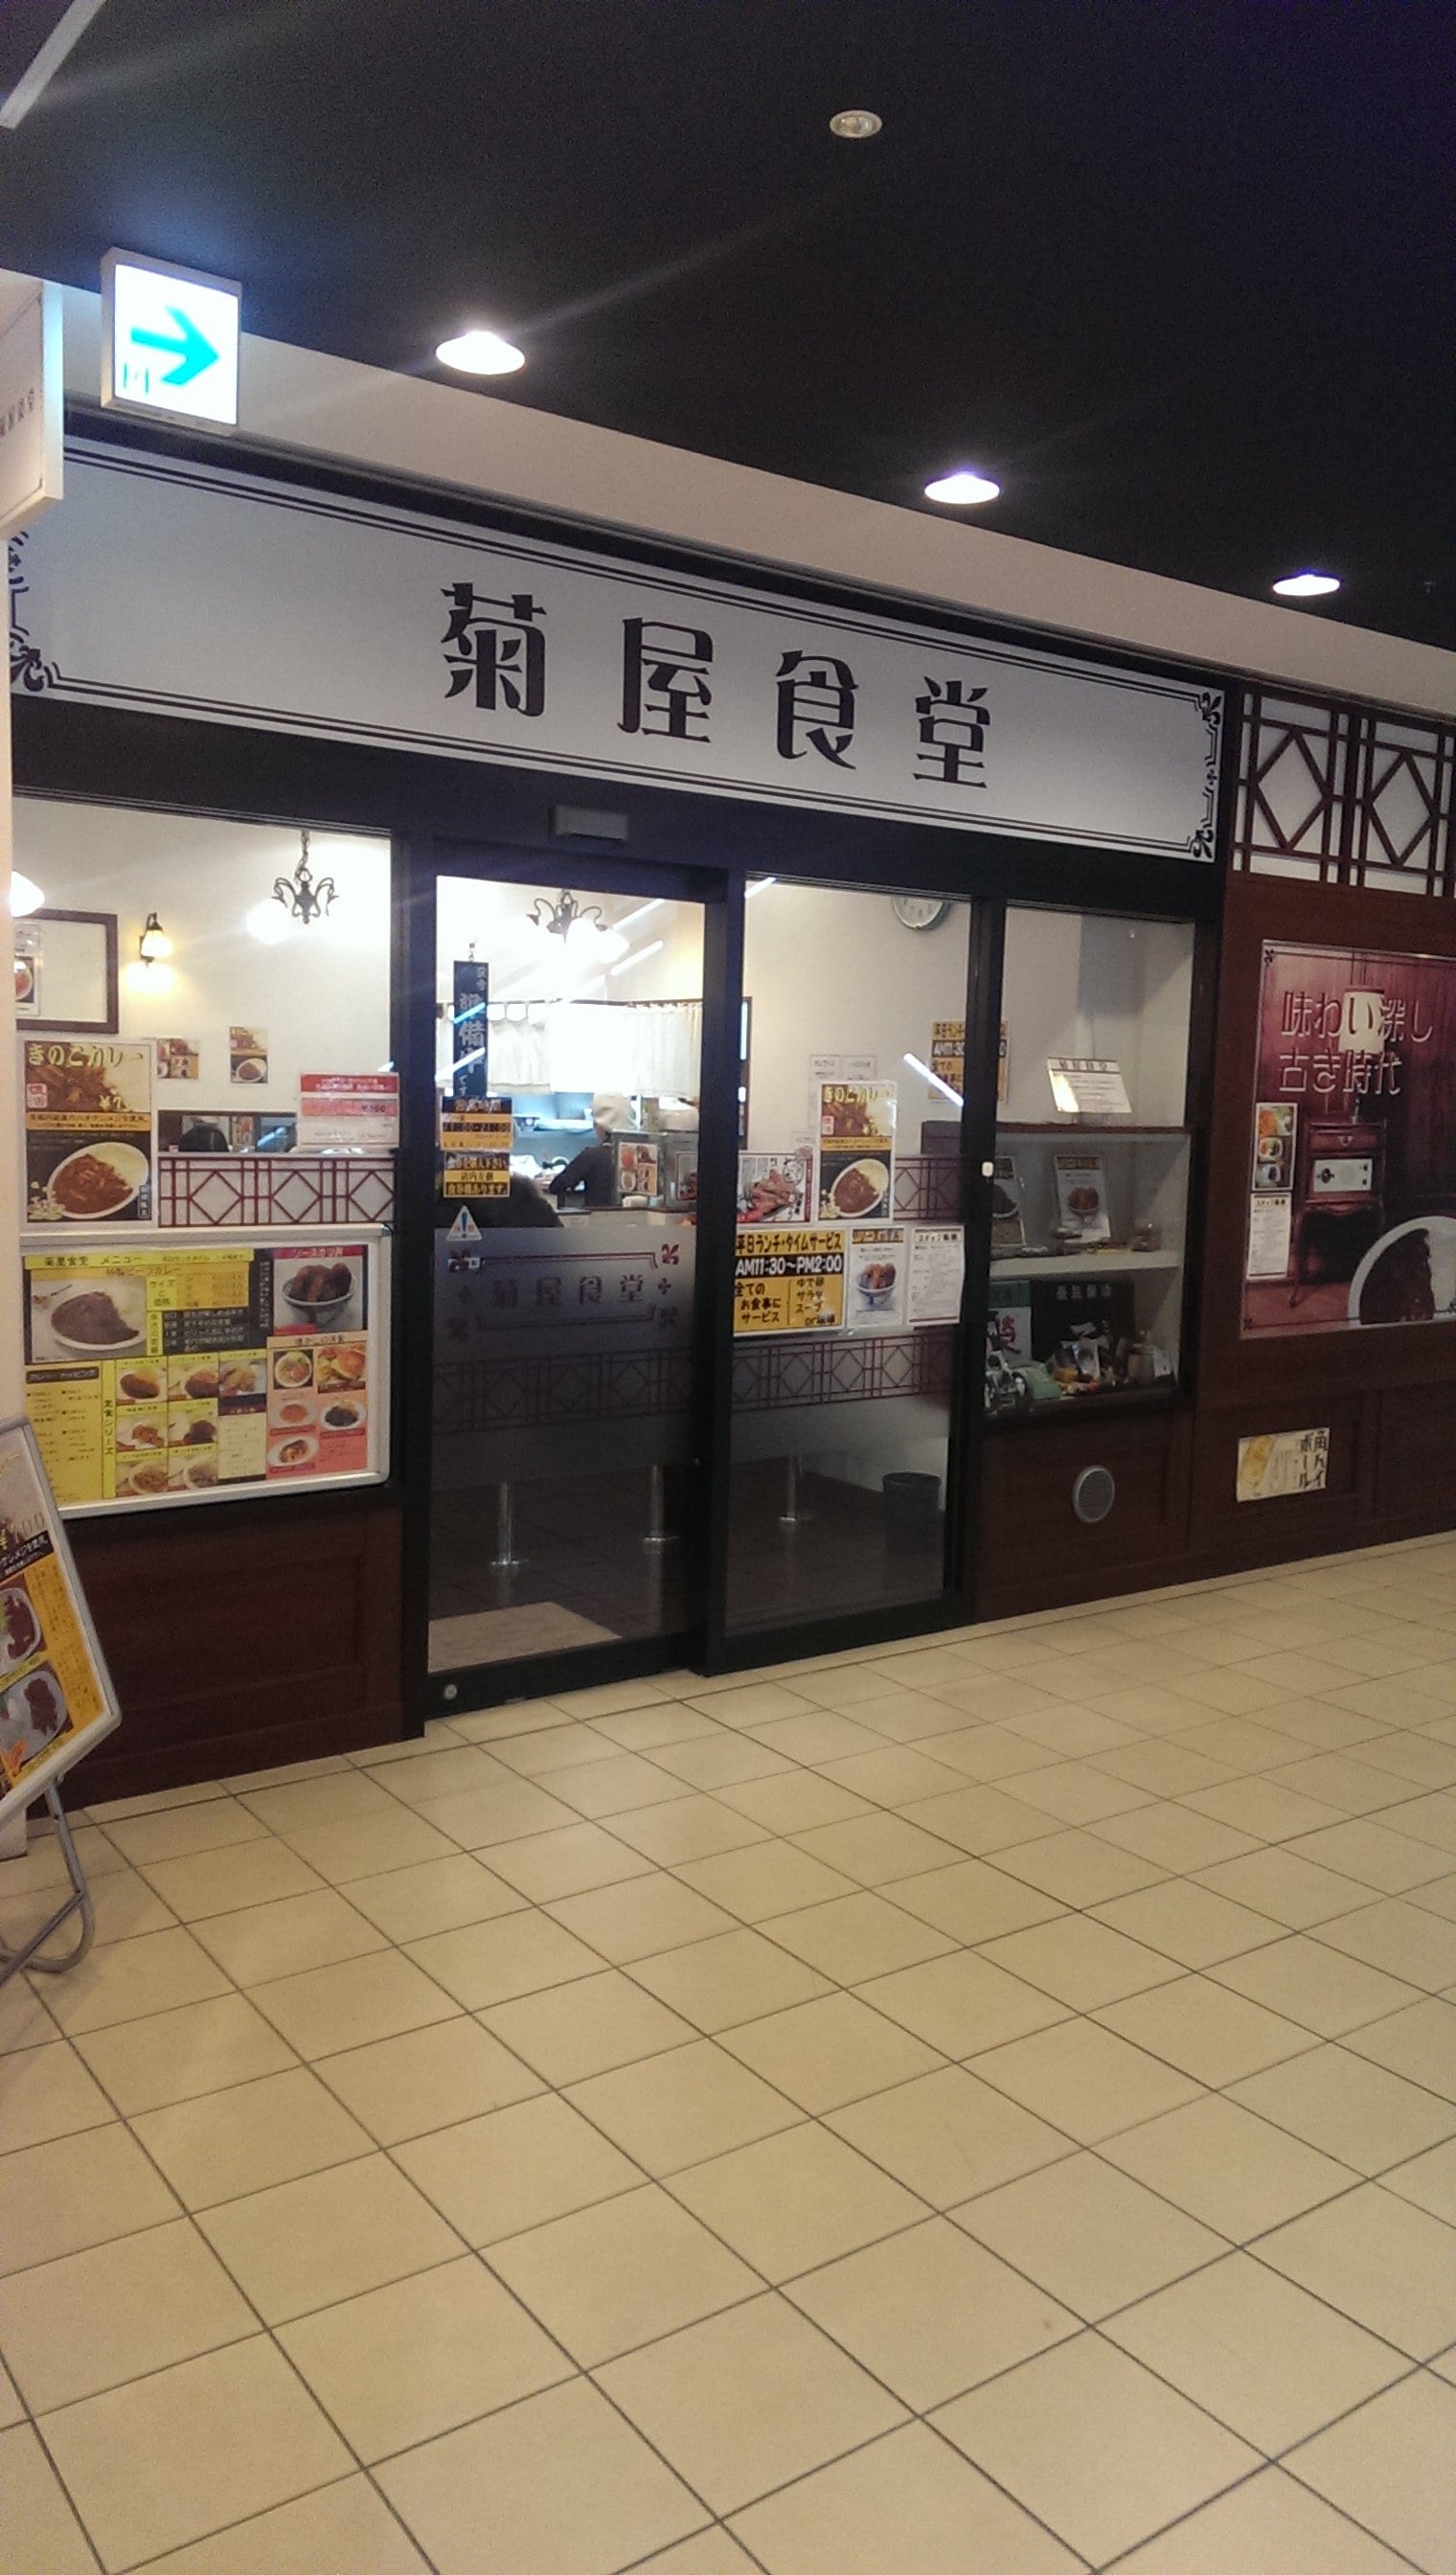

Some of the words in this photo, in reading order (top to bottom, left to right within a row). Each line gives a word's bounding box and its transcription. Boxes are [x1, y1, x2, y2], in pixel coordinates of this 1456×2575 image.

[442, 582, 990, 788] 菊屋食堂
[1282, 991, 1433, 1043] 味わい深し
[1279, 1047, 1403, 1095] 古き時代
[740, 1310, 780, 1324] サービス
